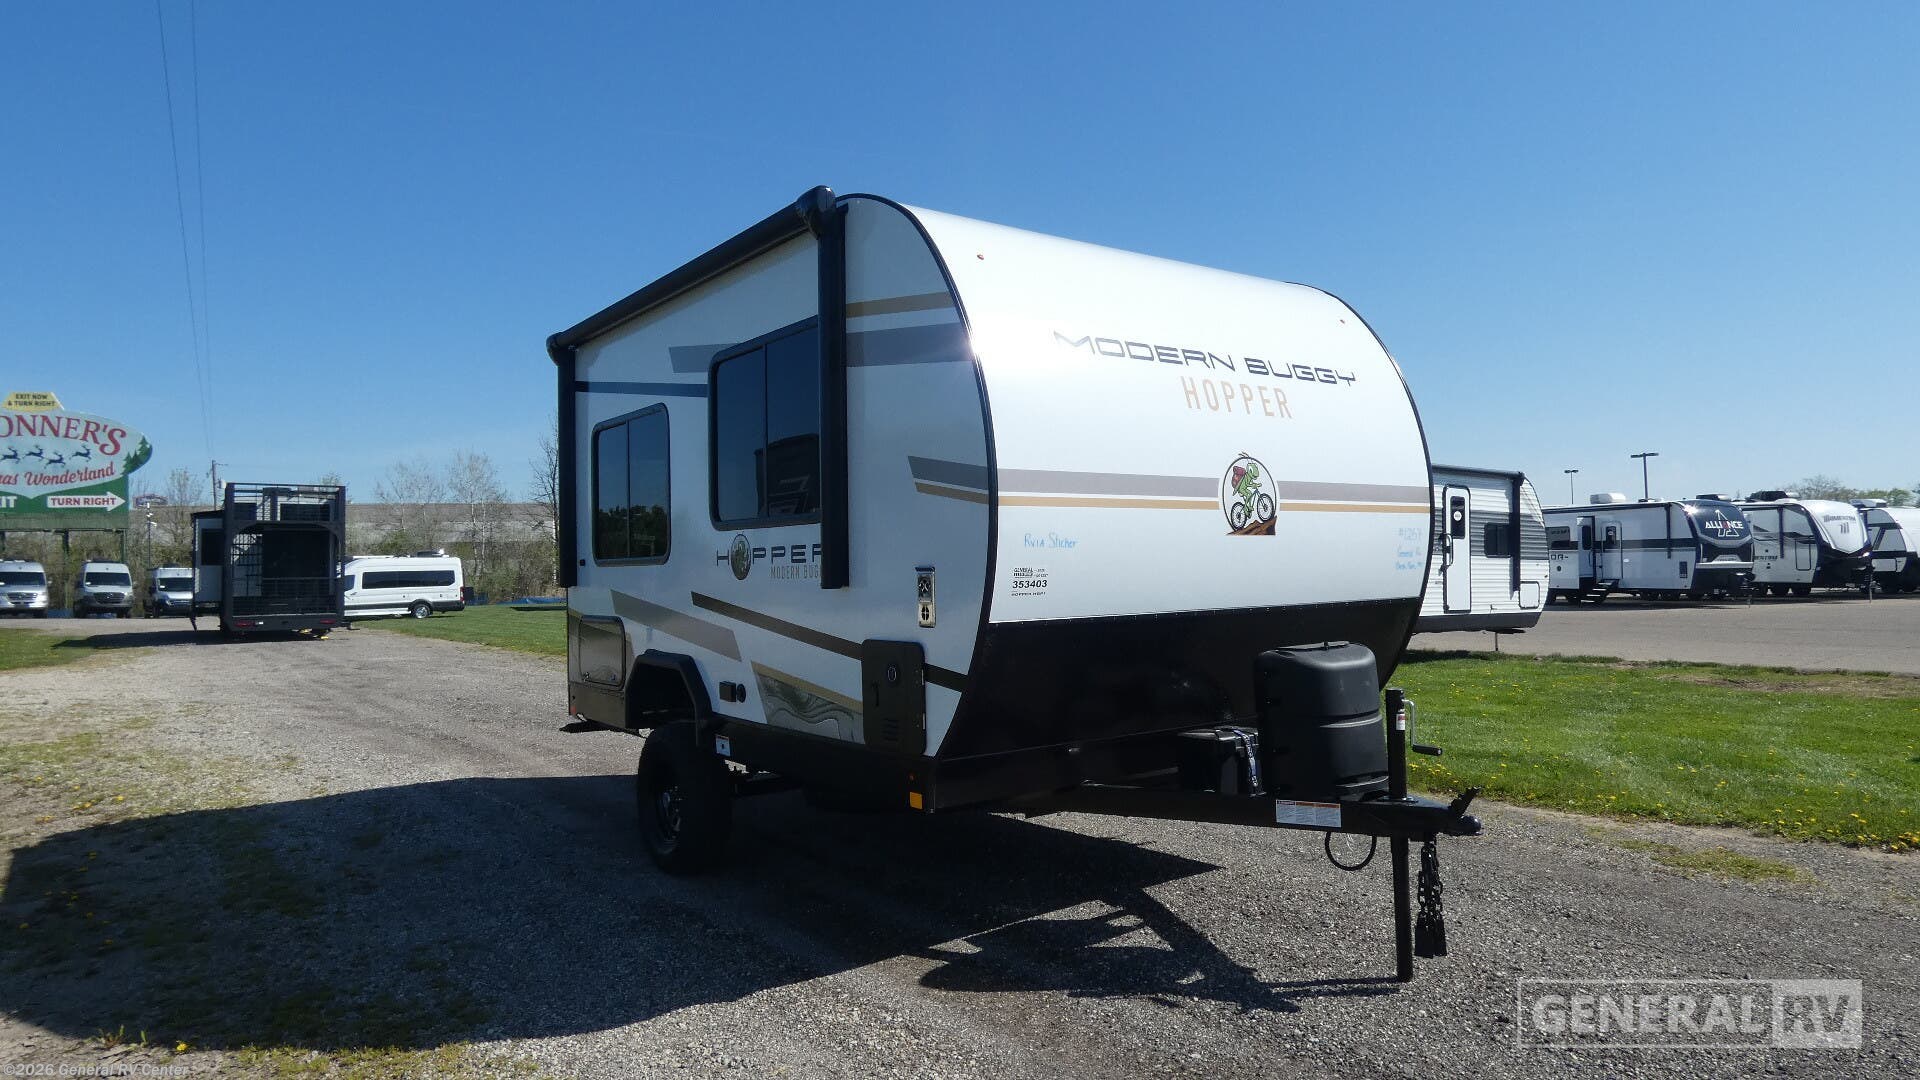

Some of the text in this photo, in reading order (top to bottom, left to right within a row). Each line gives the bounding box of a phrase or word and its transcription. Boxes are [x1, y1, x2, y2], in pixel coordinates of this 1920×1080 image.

[1053, 330, 1356, 387] MODERN BUGGY
[1180, 375, 1292, 419] HOPPER
[0, 461, 115, 486] as Wonderland
[0, 496, 117, 508] IT TURN RIGHT
[1705, 520, 1744, 529] ALLIANCE
[1012, 579, 1048, 589] 353403
